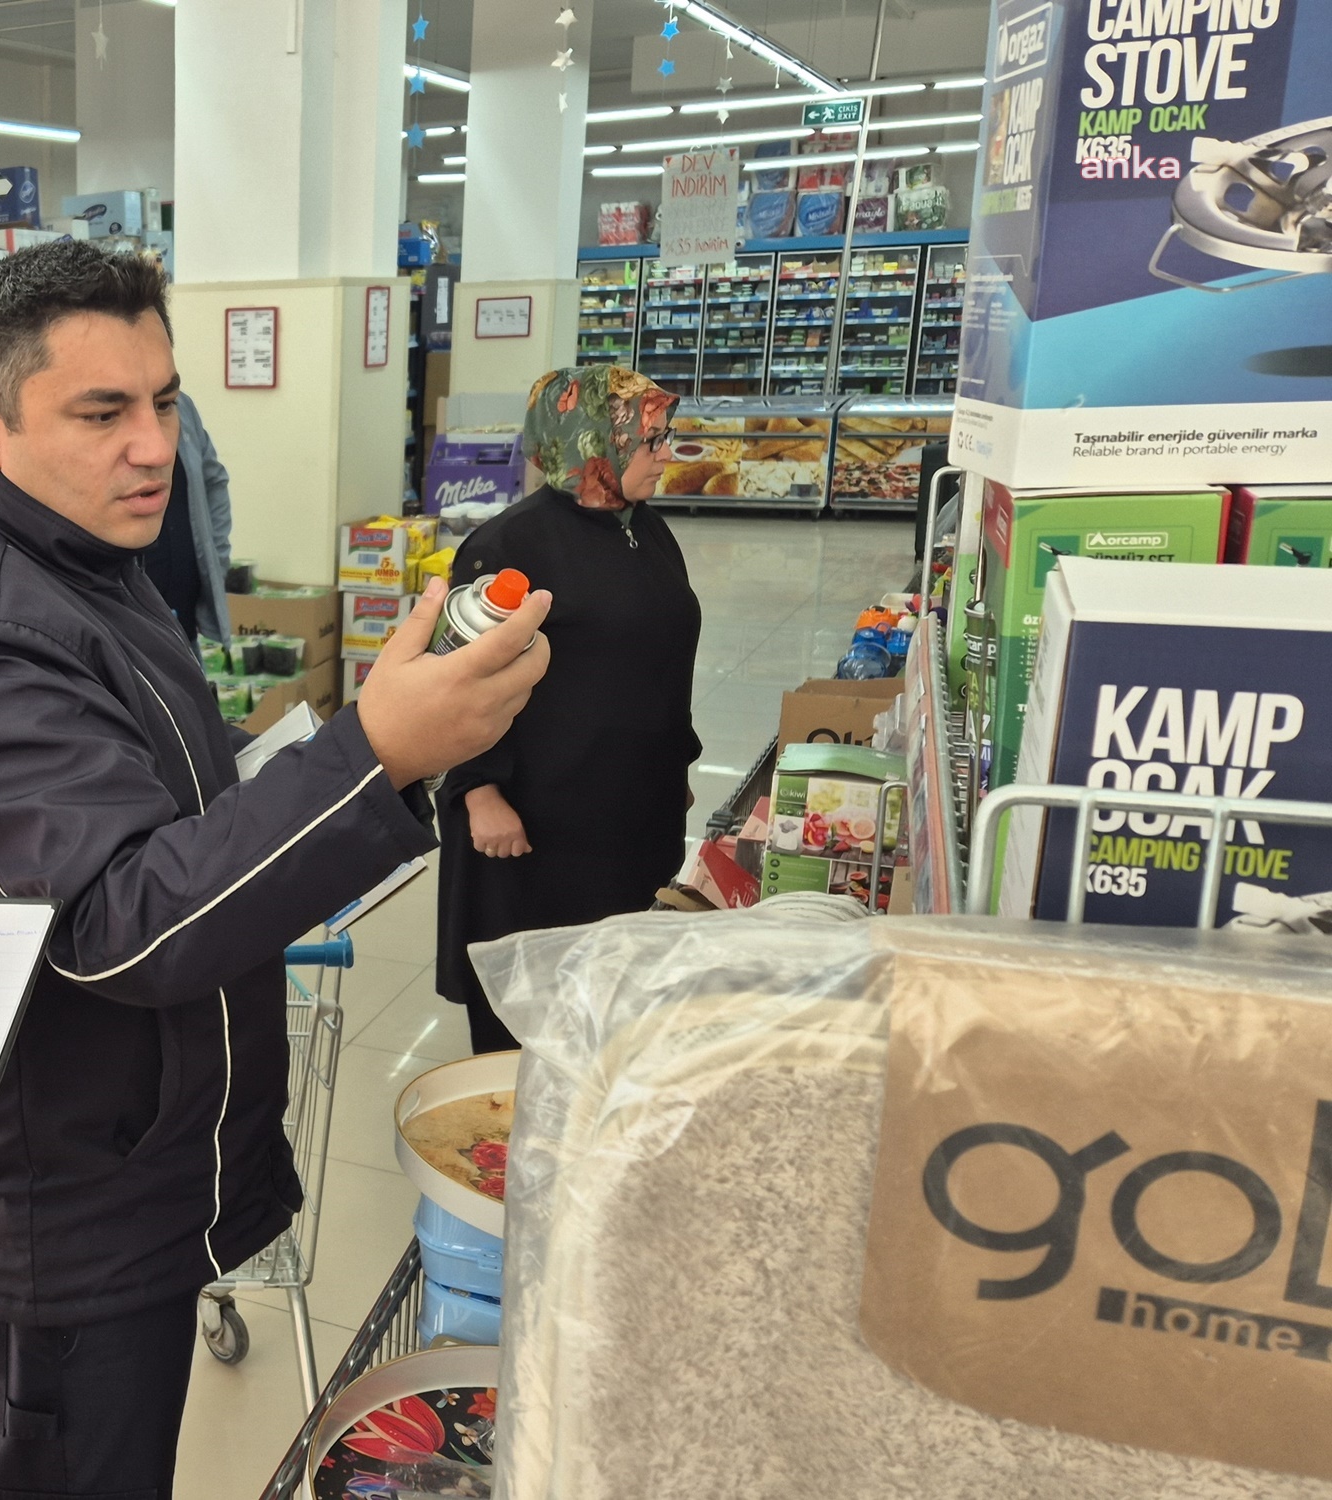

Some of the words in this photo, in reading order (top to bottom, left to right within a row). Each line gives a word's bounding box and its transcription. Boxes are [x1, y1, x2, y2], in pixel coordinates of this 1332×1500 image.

[1008, 21, 1046, 65] orgaz
[1080, 33, 1254, 108] STOVE
[837, 112, 857, 120] EXIT
[1008, 77, 1043, 135] KAMP
[1079, 108, 1142, 136] KAMP
[1149, 104, 1209, 133] OCAK
[682, 151, 715, 173] DEV
[1003, 130, 1036, 185] OCAK
[1076, 136, 1132, 163] K635
[1072, 445, 1122, 458] Reliable
[1126, 444, 1164, 456] brand
[1168, 443, 1179, 455] in
[1183, 443, 1238, 457] portable
[1241, 442, 1287, 456] energy
[1074, 432, 1144, 446] Taşınabilir
[1147, 430, 1204, 444] enerjide
[1207, 428, 1269, 443] güvenilir
[1272, 427, 1318, 439] marka
[435, 476, 497, 506] Milka
[1107, 535, 1162, 547] orcamp
[375, 569, 400, 577] JUMBO
[1092, 684, 1304, 769] KAMP
[790, 790, 806, 798] kiwi
[1087, 759, 1276, 845] OCAK
[1205, 846, 1293, 881] TOVE
[1127, 1291, 1302, 1352] home
